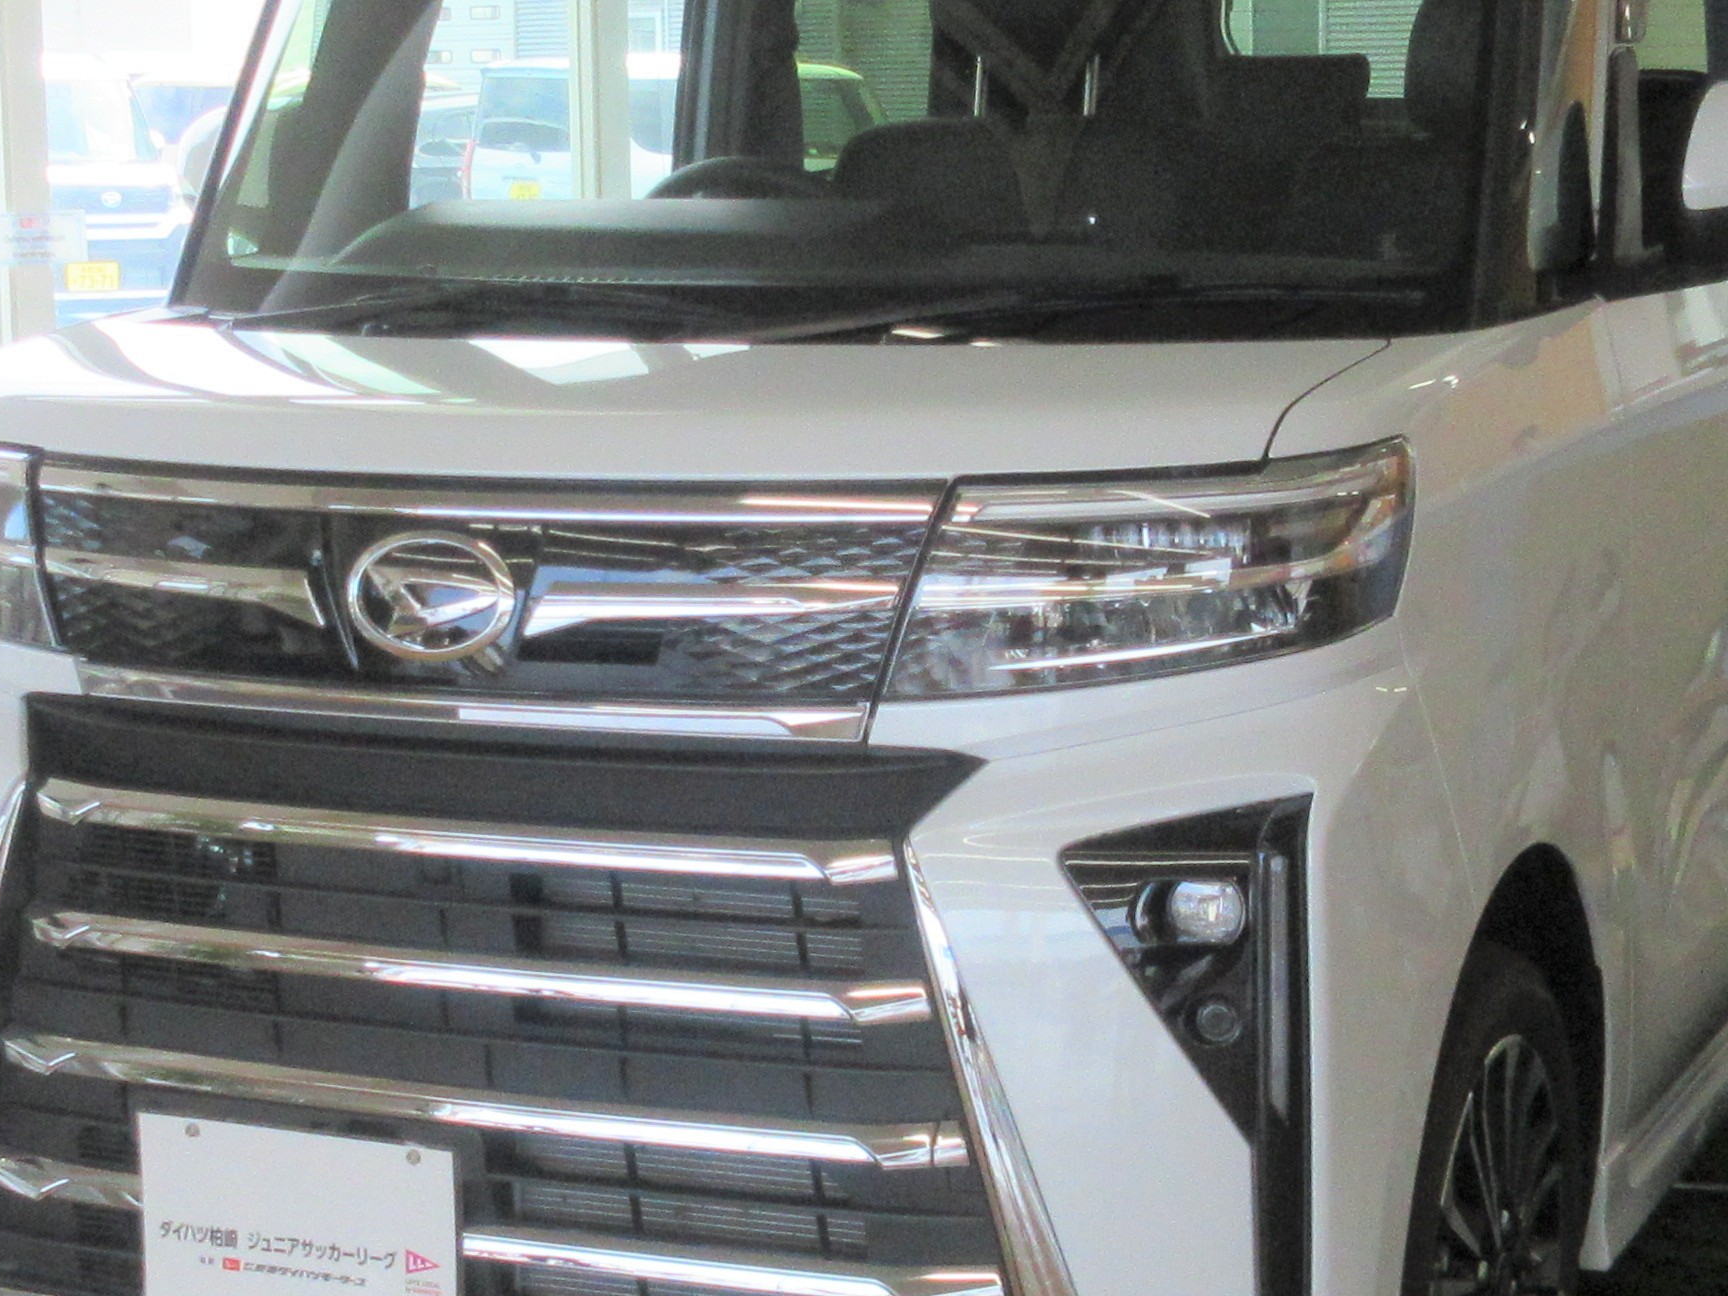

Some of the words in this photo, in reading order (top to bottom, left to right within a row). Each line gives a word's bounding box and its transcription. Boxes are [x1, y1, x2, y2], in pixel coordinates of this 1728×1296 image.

[246, 1231, 398, 1269] ジュニアサッカーリーグ
